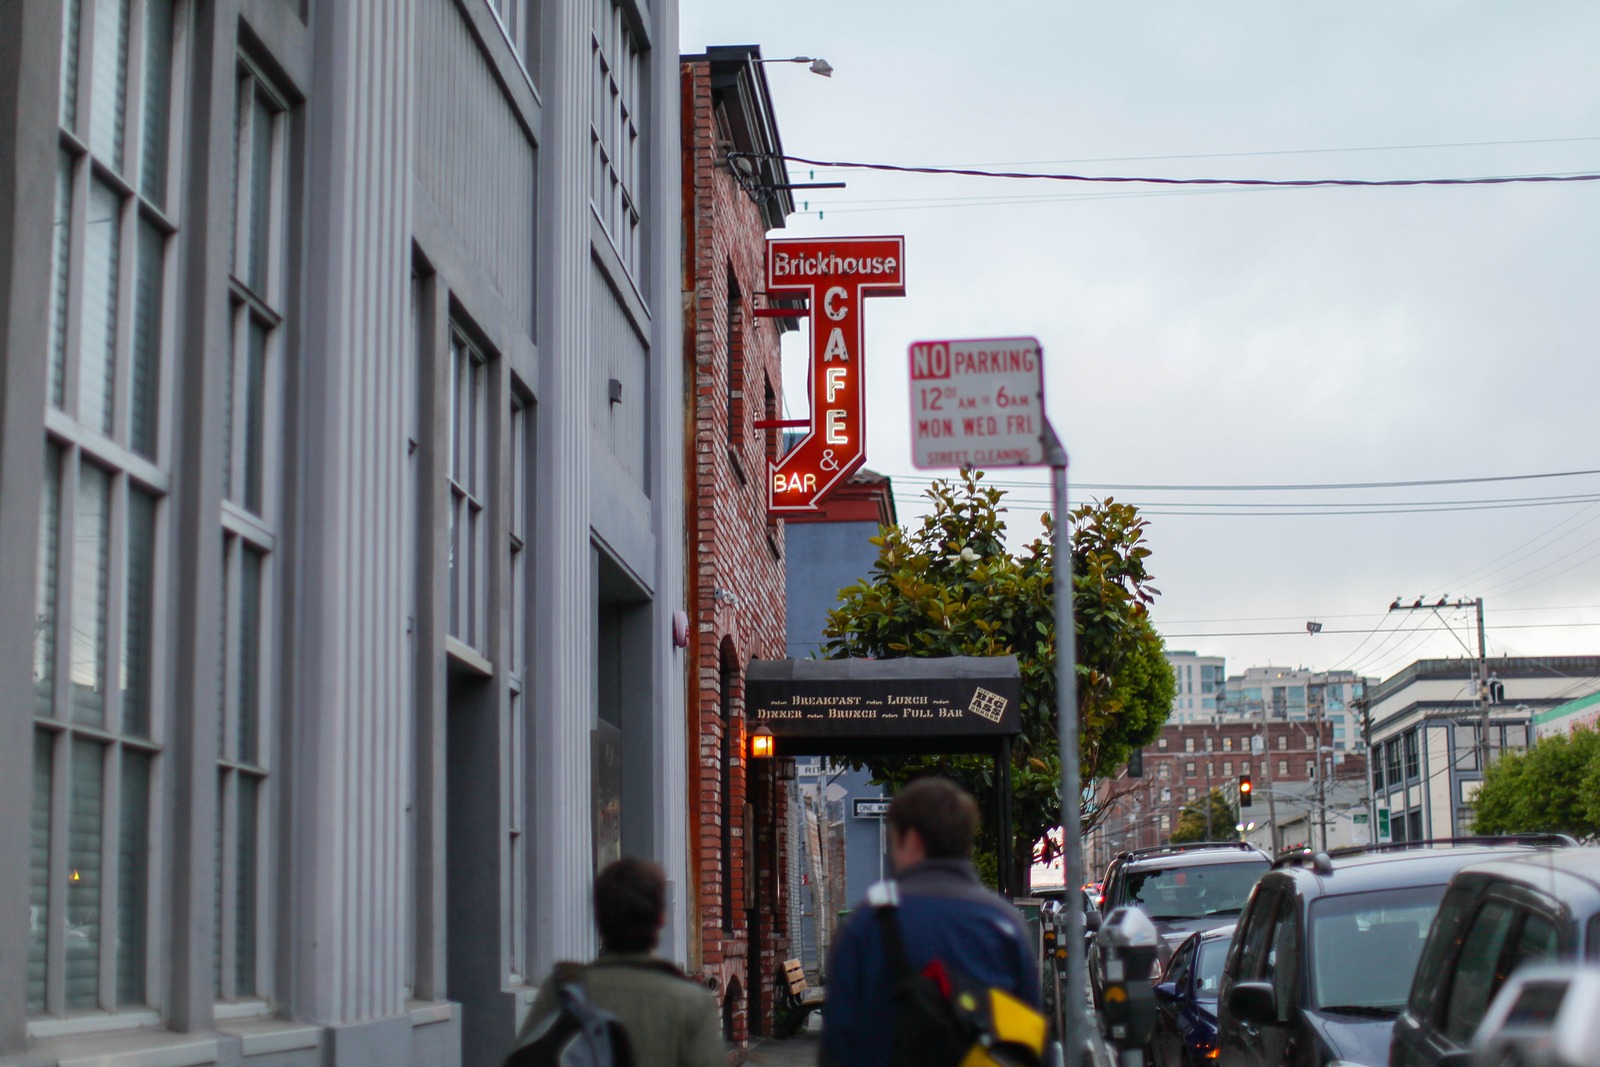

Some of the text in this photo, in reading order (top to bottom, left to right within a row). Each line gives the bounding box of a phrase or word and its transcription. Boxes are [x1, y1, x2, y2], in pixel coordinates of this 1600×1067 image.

[774, 251, 897, 276] Brickhouse
[823, 286, 849, 445] CAFE
[913, 344, 1034, 377] NO PARKING
[819, 449, 840, 471] &
[927, 447, 1031, 466] STREET CLEANING
[773, 473, 817, 493] BAR
[971, 699, 1002, 717] ASS
[975, 691, 1004, 709] BIG
[805, 766, 836, 774] RITH
[859, 804, 874, 812] ONE
